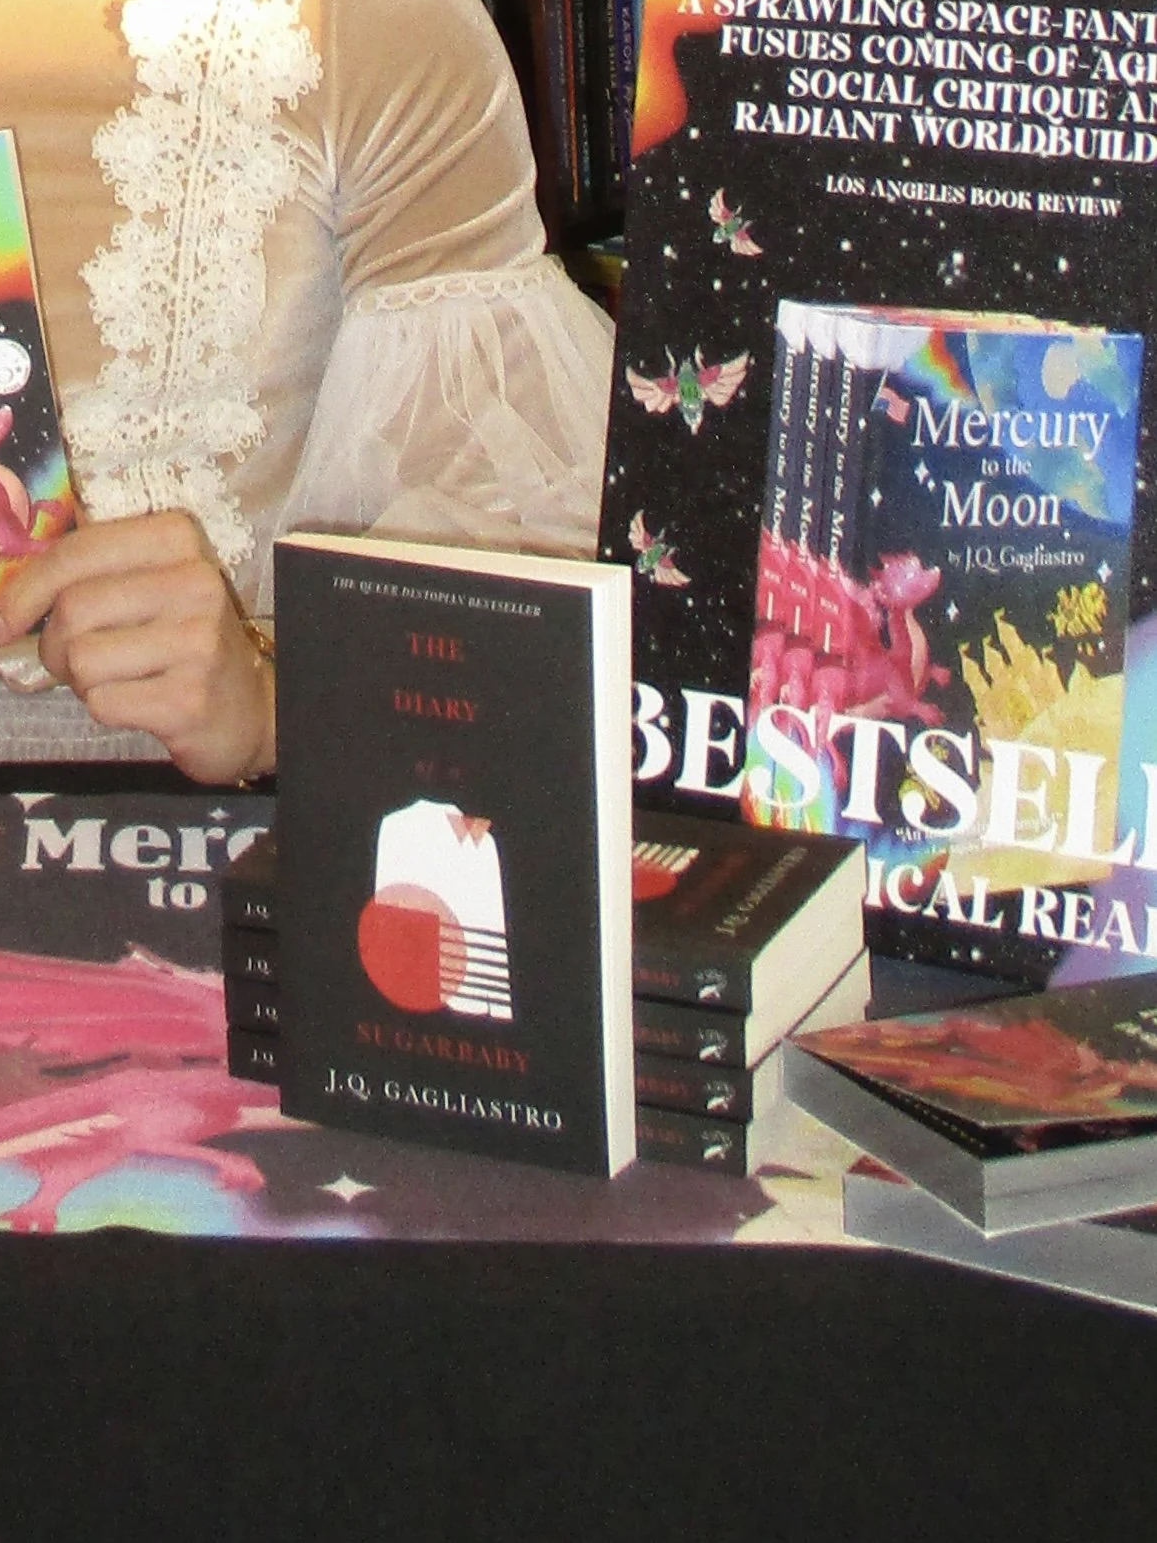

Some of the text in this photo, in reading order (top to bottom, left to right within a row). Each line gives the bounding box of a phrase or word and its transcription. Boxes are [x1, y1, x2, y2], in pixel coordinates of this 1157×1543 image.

[719, 25, 852, 62] FUSUES
[787, 67, 1110, 129] SOCIAL CRITIQUE
[734, 101, 902, 143] RADIANT
[826, 174, 1122, 219] LOS ANGELES BOOK REVIEW
[911, 396, 1110, 461] Mercury
[981, 455, 1032, 476] to the
[941, 480, 1061, 528] Moon
[1000, 544, 1085, 573] Gagliastro
[332, 576, 356, 590] THE
[359, 578, 399, 597] QUEER
[467, 596, 541, 618] BESTSELLER
[406, 631, 465, 663] THE
[393, 688, 479, 723] DIARY
[146, 876, 209, 910] to
[865, 857, 1009, 928] ICAL
[356, 1022, 530, 1074] SUGARBABY
[324, 1068, 563, 1131] J.Q. GAGLIASTRO
